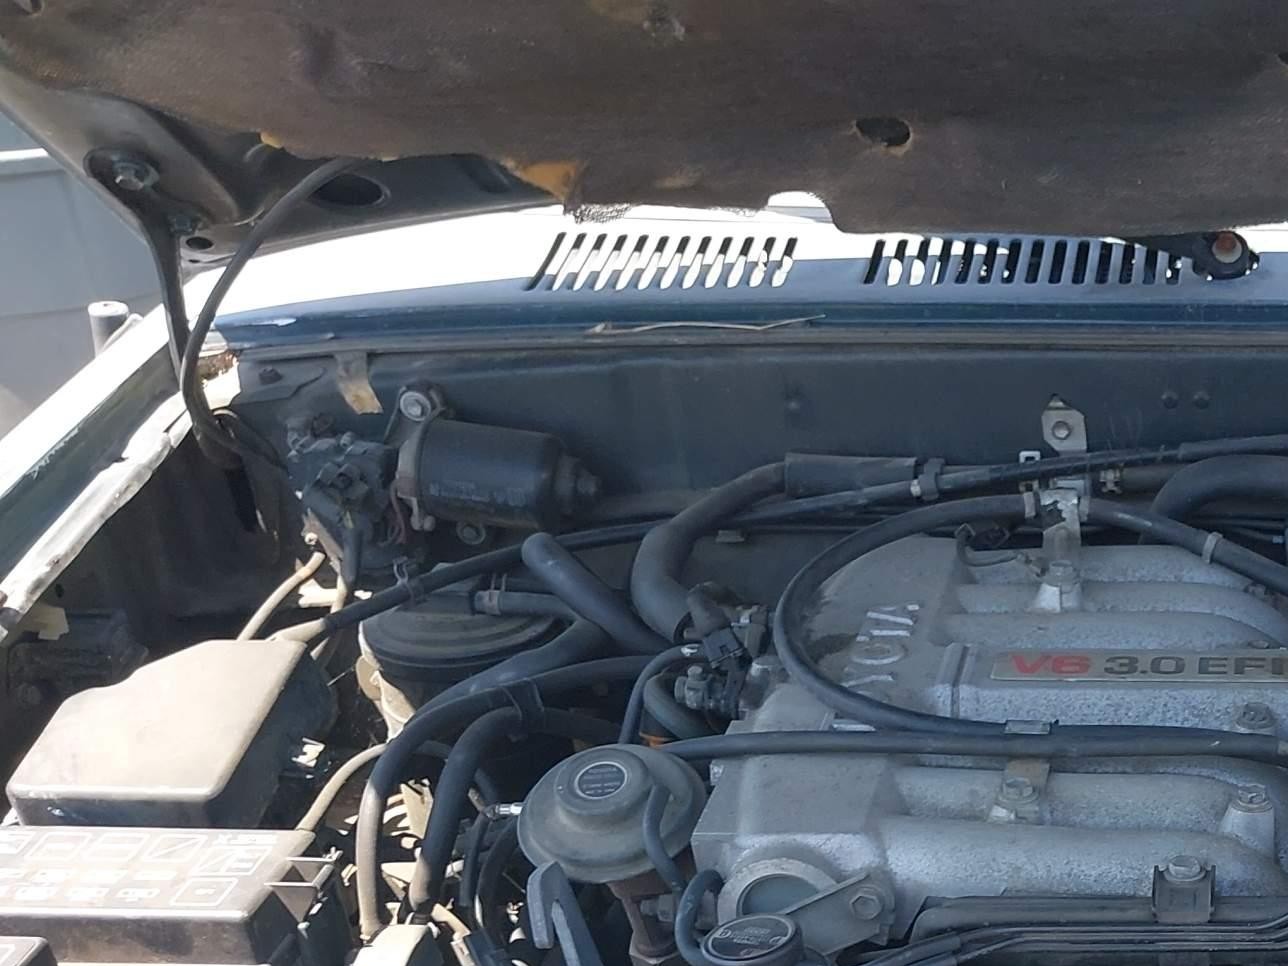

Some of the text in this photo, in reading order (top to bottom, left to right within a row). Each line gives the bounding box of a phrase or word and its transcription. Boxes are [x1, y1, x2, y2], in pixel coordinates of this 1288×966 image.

[1011, 655, 1286, 676] V6 3.0 EFI
